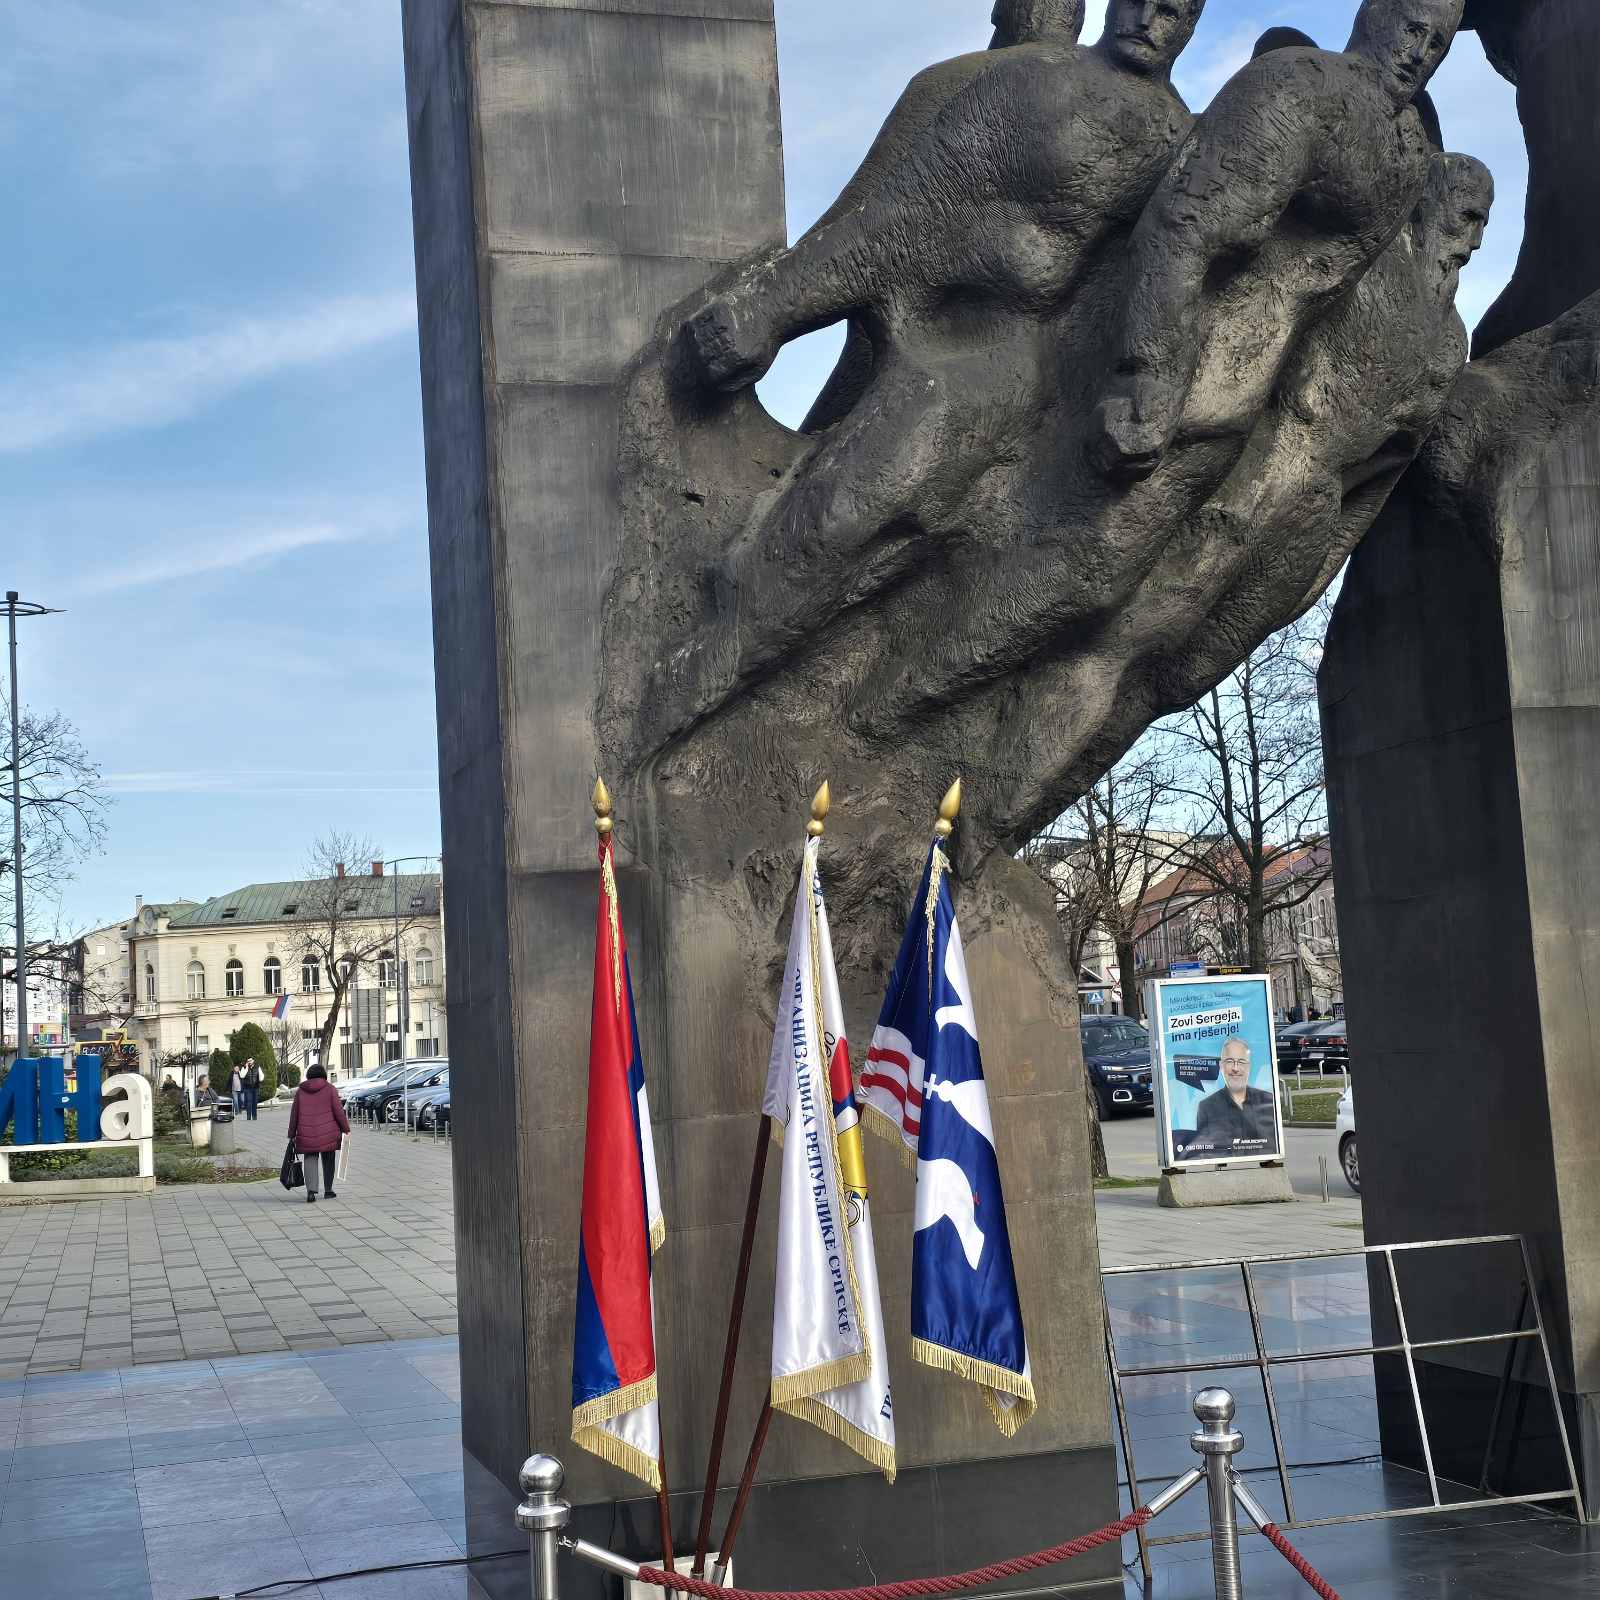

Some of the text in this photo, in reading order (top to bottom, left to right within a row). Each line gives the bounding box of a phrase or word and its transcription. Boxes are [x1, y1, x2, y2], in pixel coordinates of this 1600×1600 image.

[1170, 1010, 1240, 1028] Zovi Sergeja,
[1171, 1023, 1239, 1042] ima rješenje!
[805, 1131, 838, 1251] РЕПУБЛИКЕ
[828, 1255, 850, 1336] СРПСКЕ
